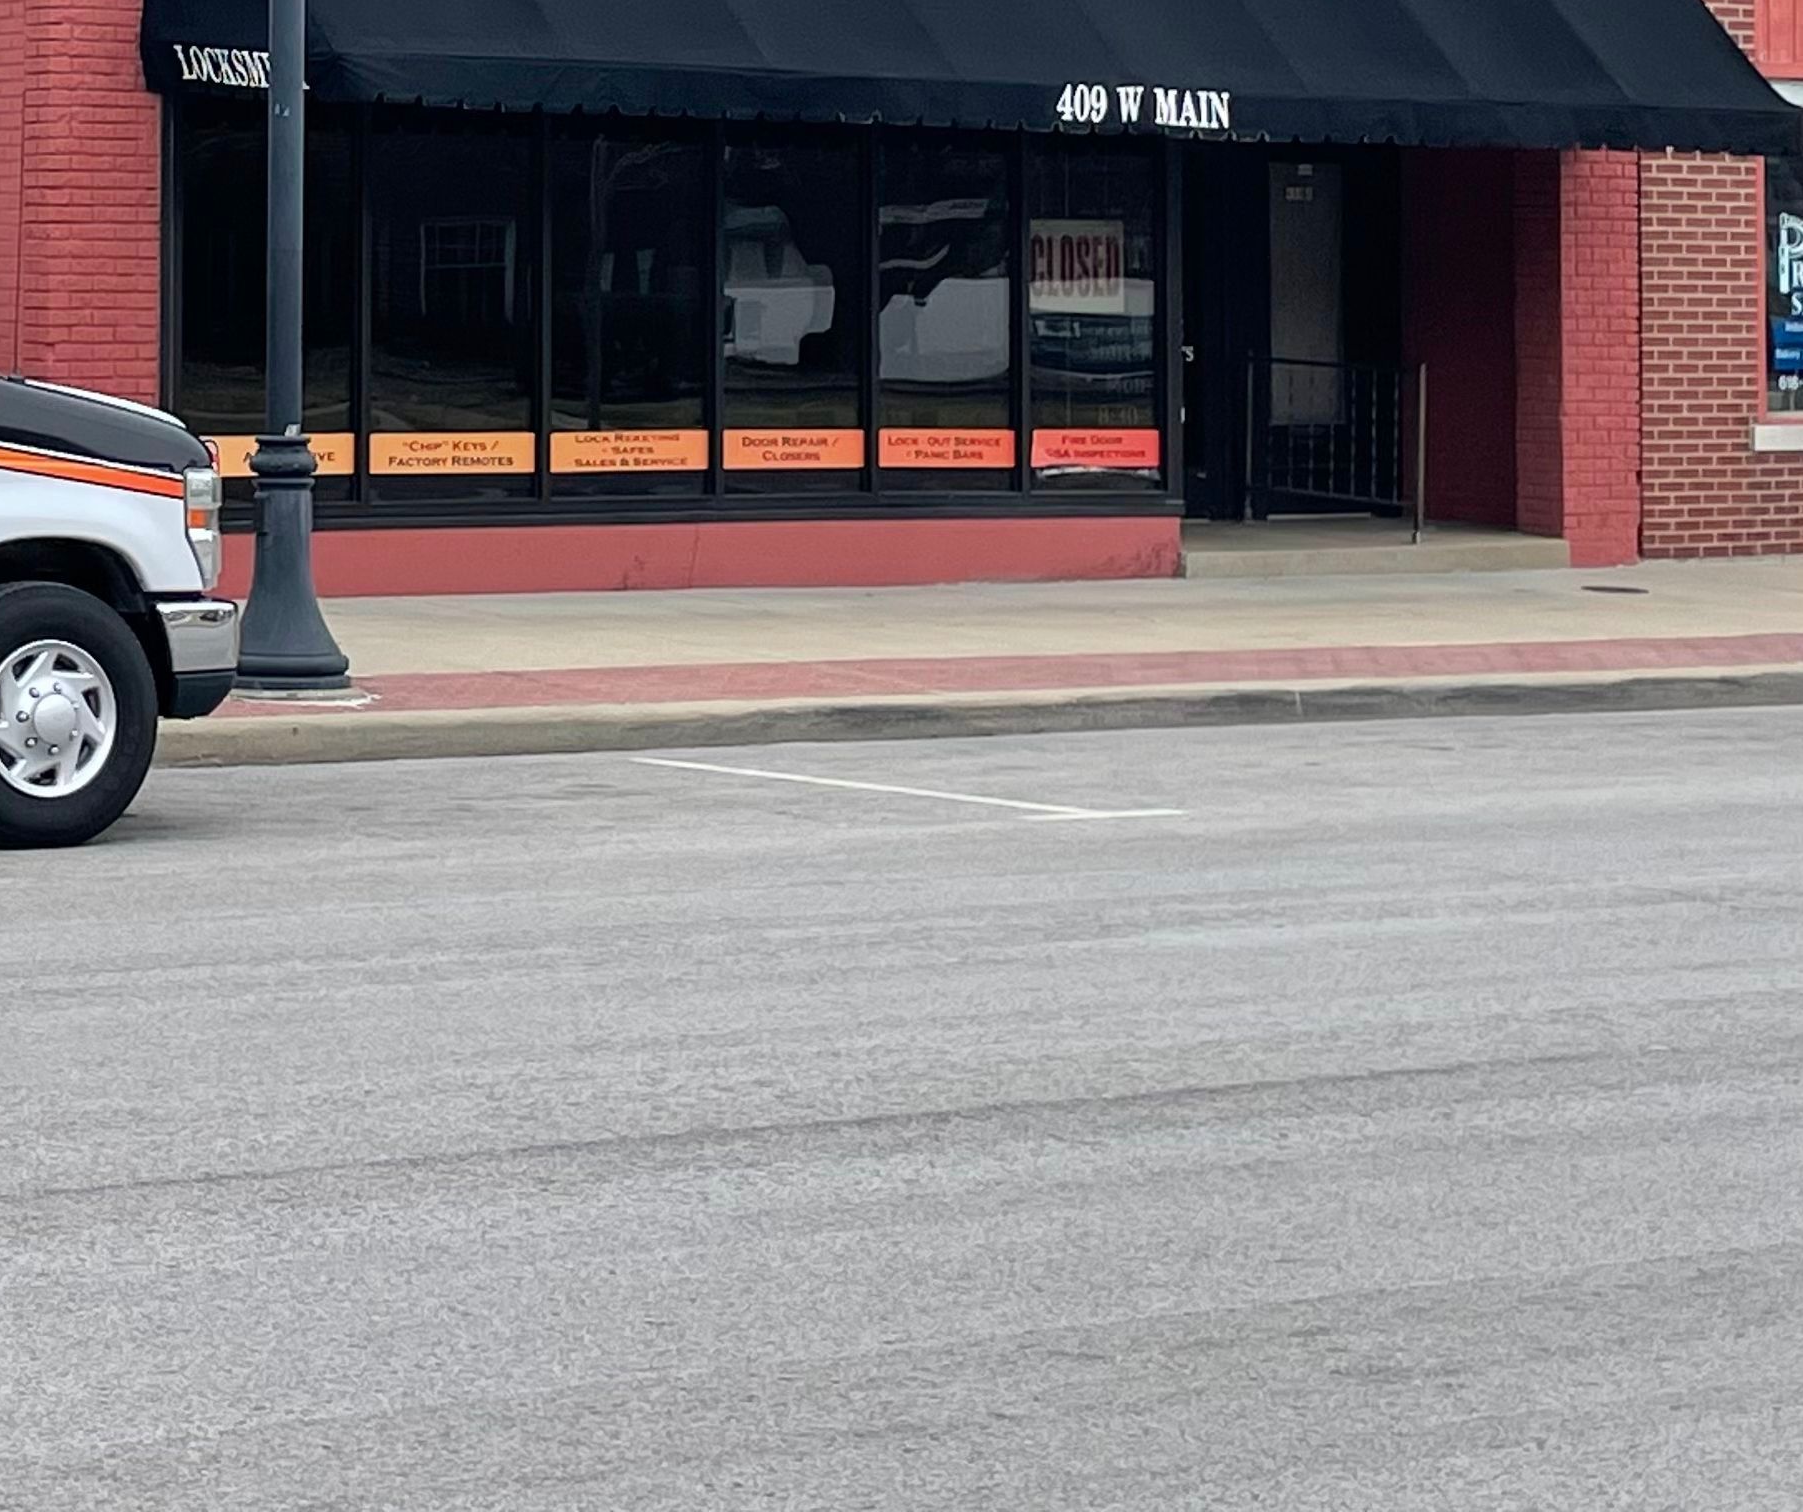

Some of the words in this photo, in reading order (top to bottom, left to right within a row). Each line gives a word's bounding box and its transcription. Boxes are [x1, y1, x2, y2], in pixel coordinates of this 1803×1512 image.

[173, 45, 310, 90] LOCKSM
[1056, 84, 1108, 123] 409
[1116, 86, 1145, 123] W
[1153, 88, 1230, 129] MAIN
[1031, 234, 1121, 298] CLOSED
